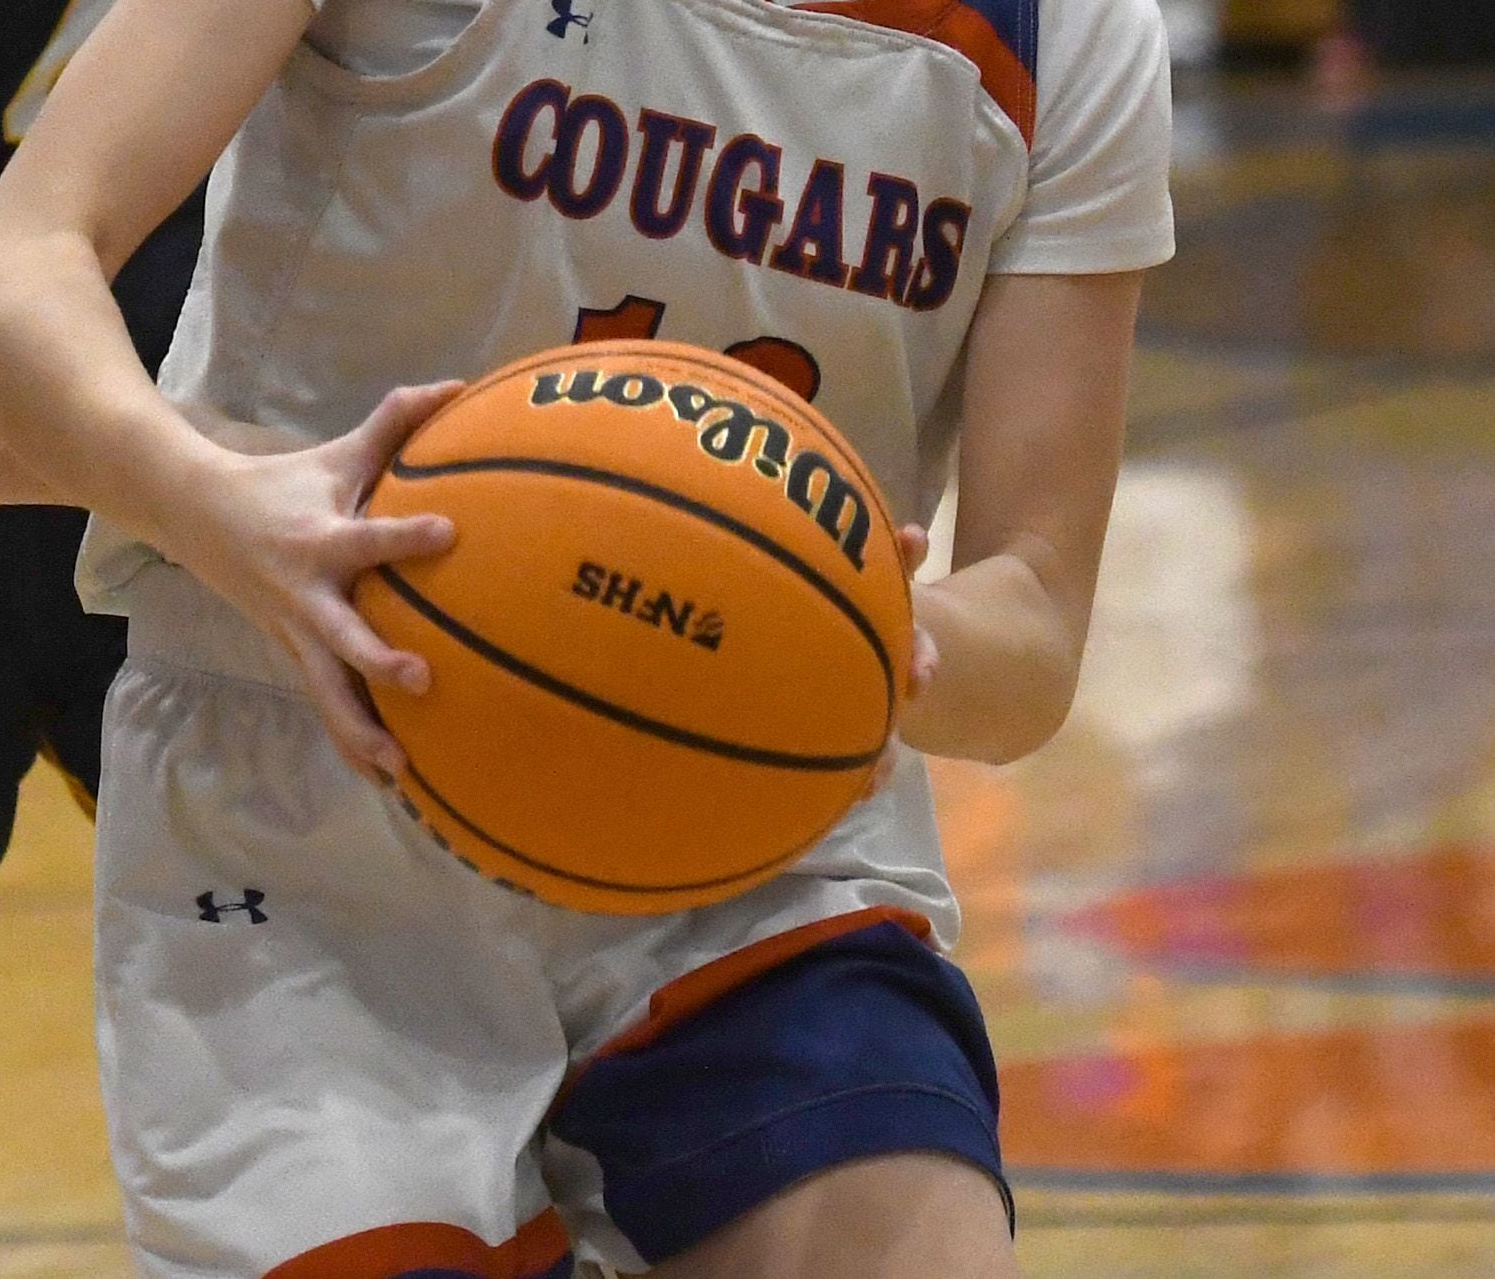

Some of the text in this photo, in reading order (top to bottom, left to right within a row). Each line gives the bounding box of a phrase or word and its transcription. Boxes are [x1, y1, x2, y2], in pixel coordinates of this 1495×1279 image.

[491, 78, 972, 312] COUGARS
[528, 369, 872, 575] Wilson
[572, 561, 696, 637] NFHS
